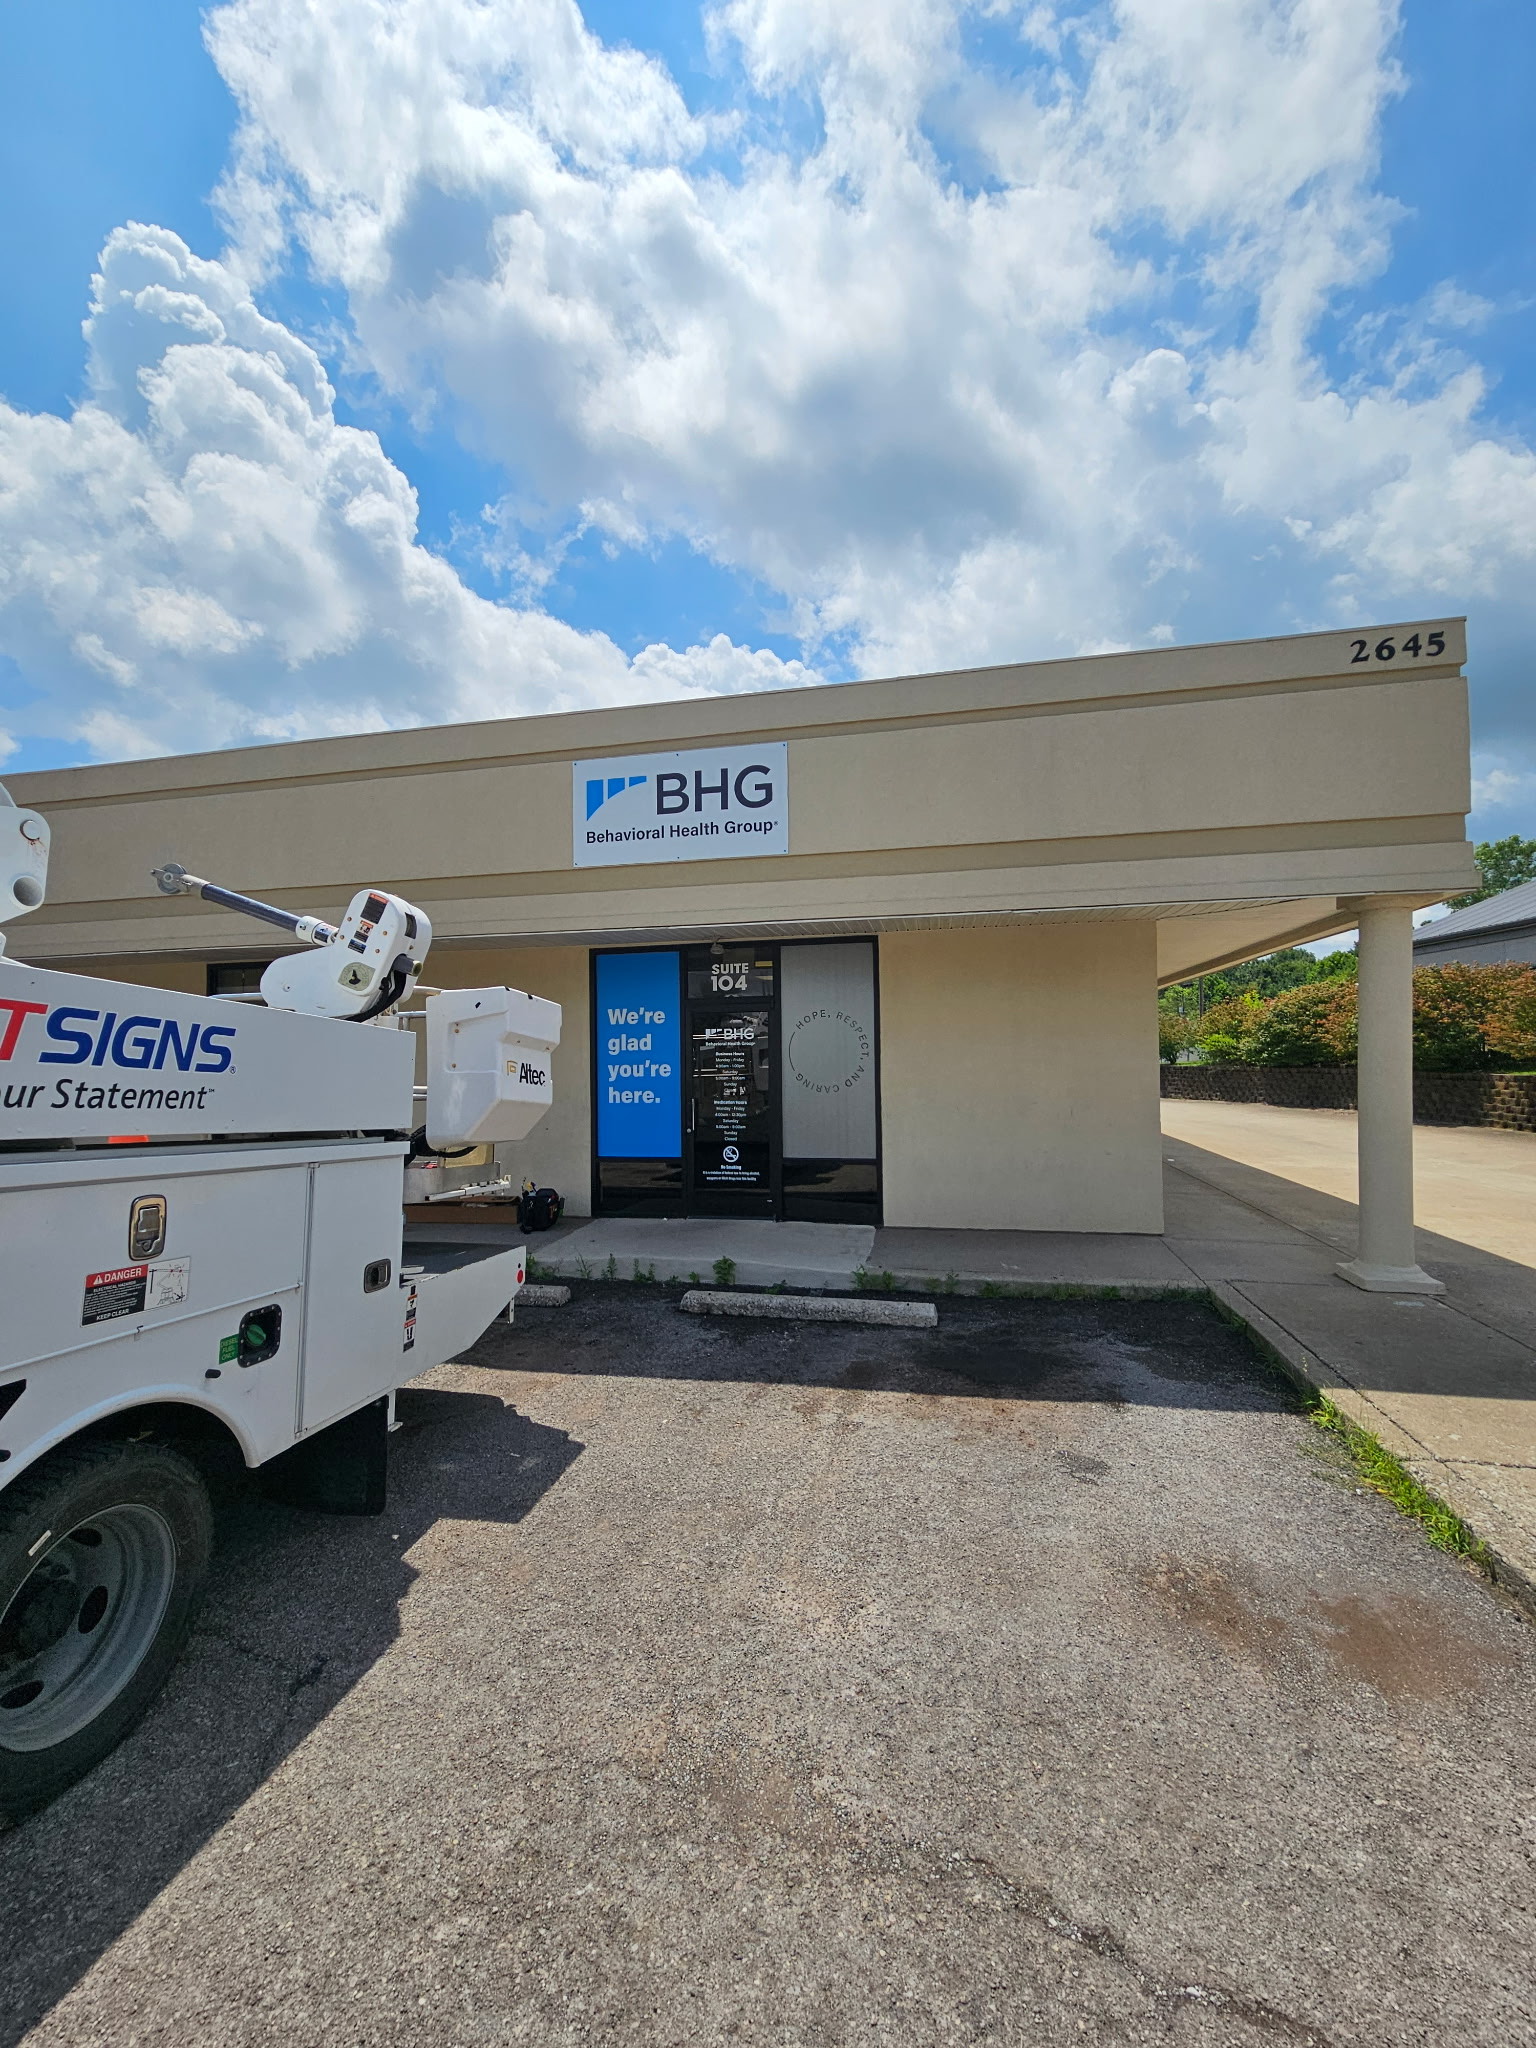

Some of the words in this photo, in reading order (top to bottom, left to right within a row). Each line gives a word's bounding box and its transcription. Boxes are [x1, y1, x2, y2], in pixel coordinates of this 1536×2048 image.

[1350, 631, 1445, 664] 2645
[656, 764, 773, 815] BHG
[586, 825, 665, 844] Behavioral
[669, 822, 719, 838] Health
[711, 962, 749, 975] SUITE
[711, 974, 748, 991] 104
[607, 1007, 666, 1025] We're
[795, 1009, 831, 1030] HOPE,
[723, 1027, 755, 1040] BHG
[836, 1011, 869, 1060] RESPECT,
[608, 1033, 652, 1056] glad
[519, 1062, 546, 1086] Altec
[608, 1060, 672, 1082] you're
[844, 1065, 865, 1087] AND
[795, 1073, 840, 1094] CARING
[0, 1083, 46, 1109] ur
[608, 1086, 661, 1104] here.
[104, 1267, 142, 1283] DANGER
[96, 1312, 112, 1321] KEEP
[111, 1308, 130, 1317] CLEAR
